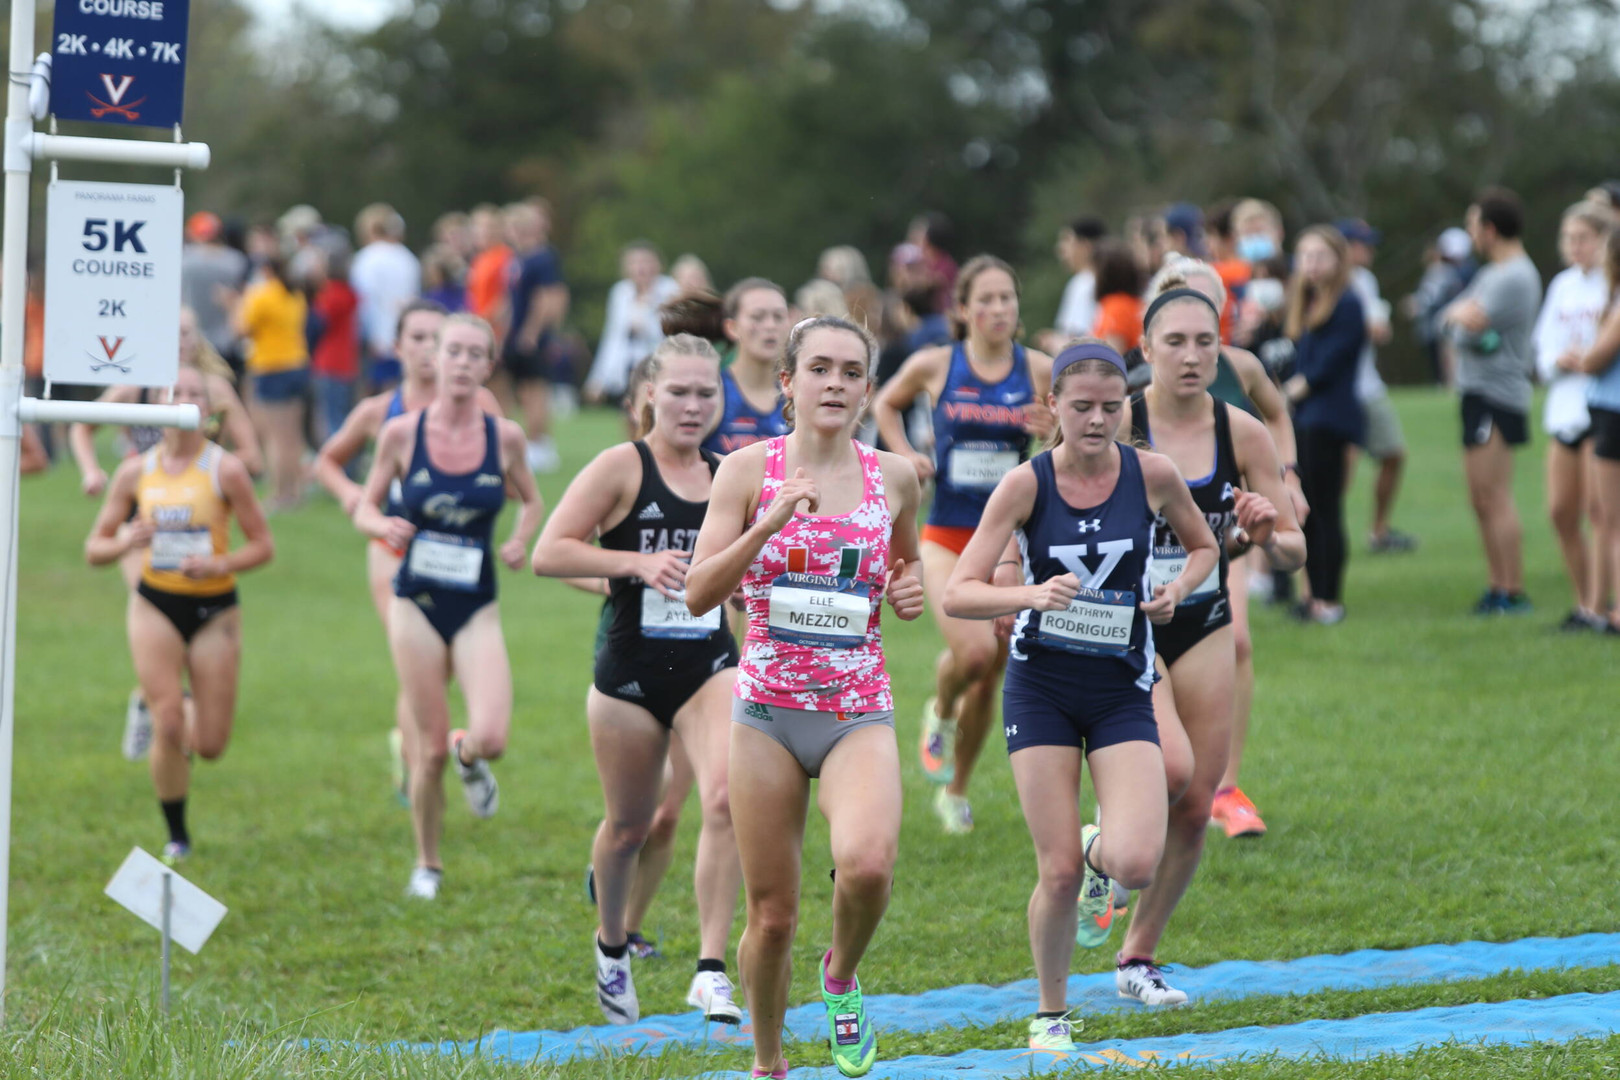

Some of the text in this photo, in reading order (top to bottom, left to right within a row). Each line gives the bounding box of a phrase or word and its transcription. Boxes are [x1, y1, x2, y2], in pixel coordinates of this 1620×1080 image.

[79, 0, 164, 20] COURSE
[57, 33, 181, 64] 2K 4K 7K
[81, 217, 148, 253] 5K
[72, 258, 155, 278] COURSE
[98, 299, 126, 318] 2K
[639, 528, 700, 554] EAST
[787, 572, 839, 587] VIRGINIA
[809, 595, 834, 607] ELLE
[789, 610, 849, 629] MEZZIO
[1045, 614, 1128, 639] RODRIGUES
[744, 707, 774, 722] adidas
